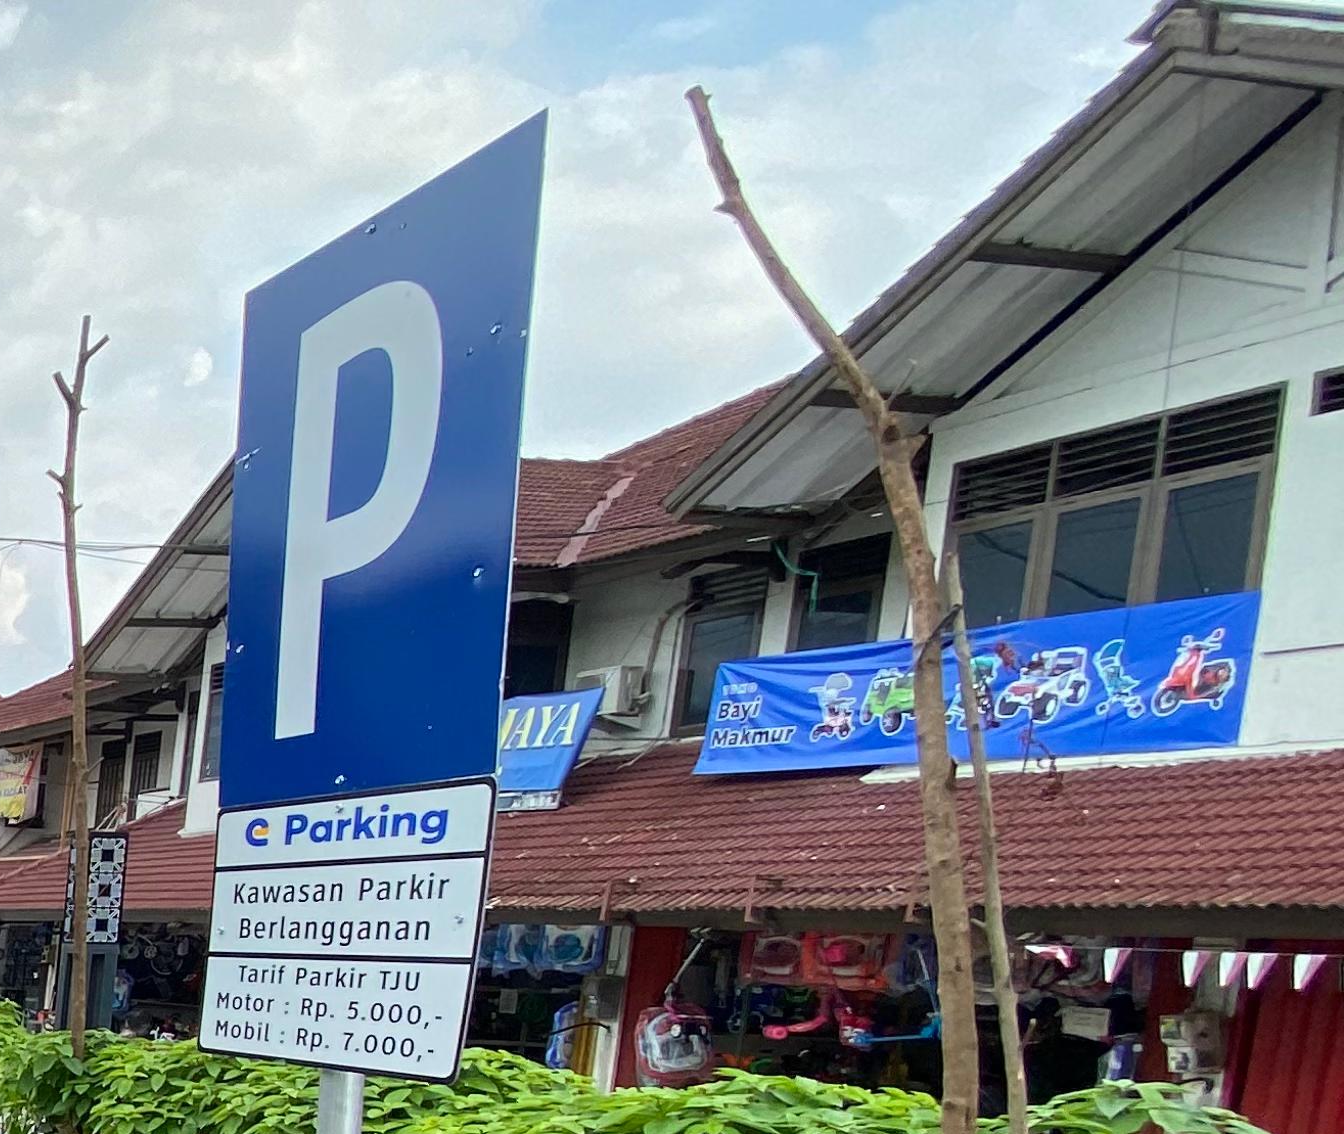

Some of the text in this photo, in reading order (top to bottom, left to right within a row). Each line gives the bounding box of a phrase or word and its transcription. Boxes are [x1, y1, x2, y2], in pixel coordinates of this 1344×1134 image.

[274, 280, 443, 740] P
[715, 695, 762, 723] Bayi
[711, 725, 797, 748] Makmur
[285, 804, 449, 845] Parking
[233, 872, 451, 905] Kawasan Parkir
[238, 916, 431, 947] Berlangganan
[238, 964, 421, 992] Tarif Parkir TJU
[215, 992, 275, 1013] Motor
[300, 998, 335, 1022] Rp.
[347, 1001, 443, 1029] 5.000,-
[215, 1020, 270, 1042] Mobil
[295, 1028, 330, 1051] Rp.
[343, 1032, 434, 1062] 7.000,-
